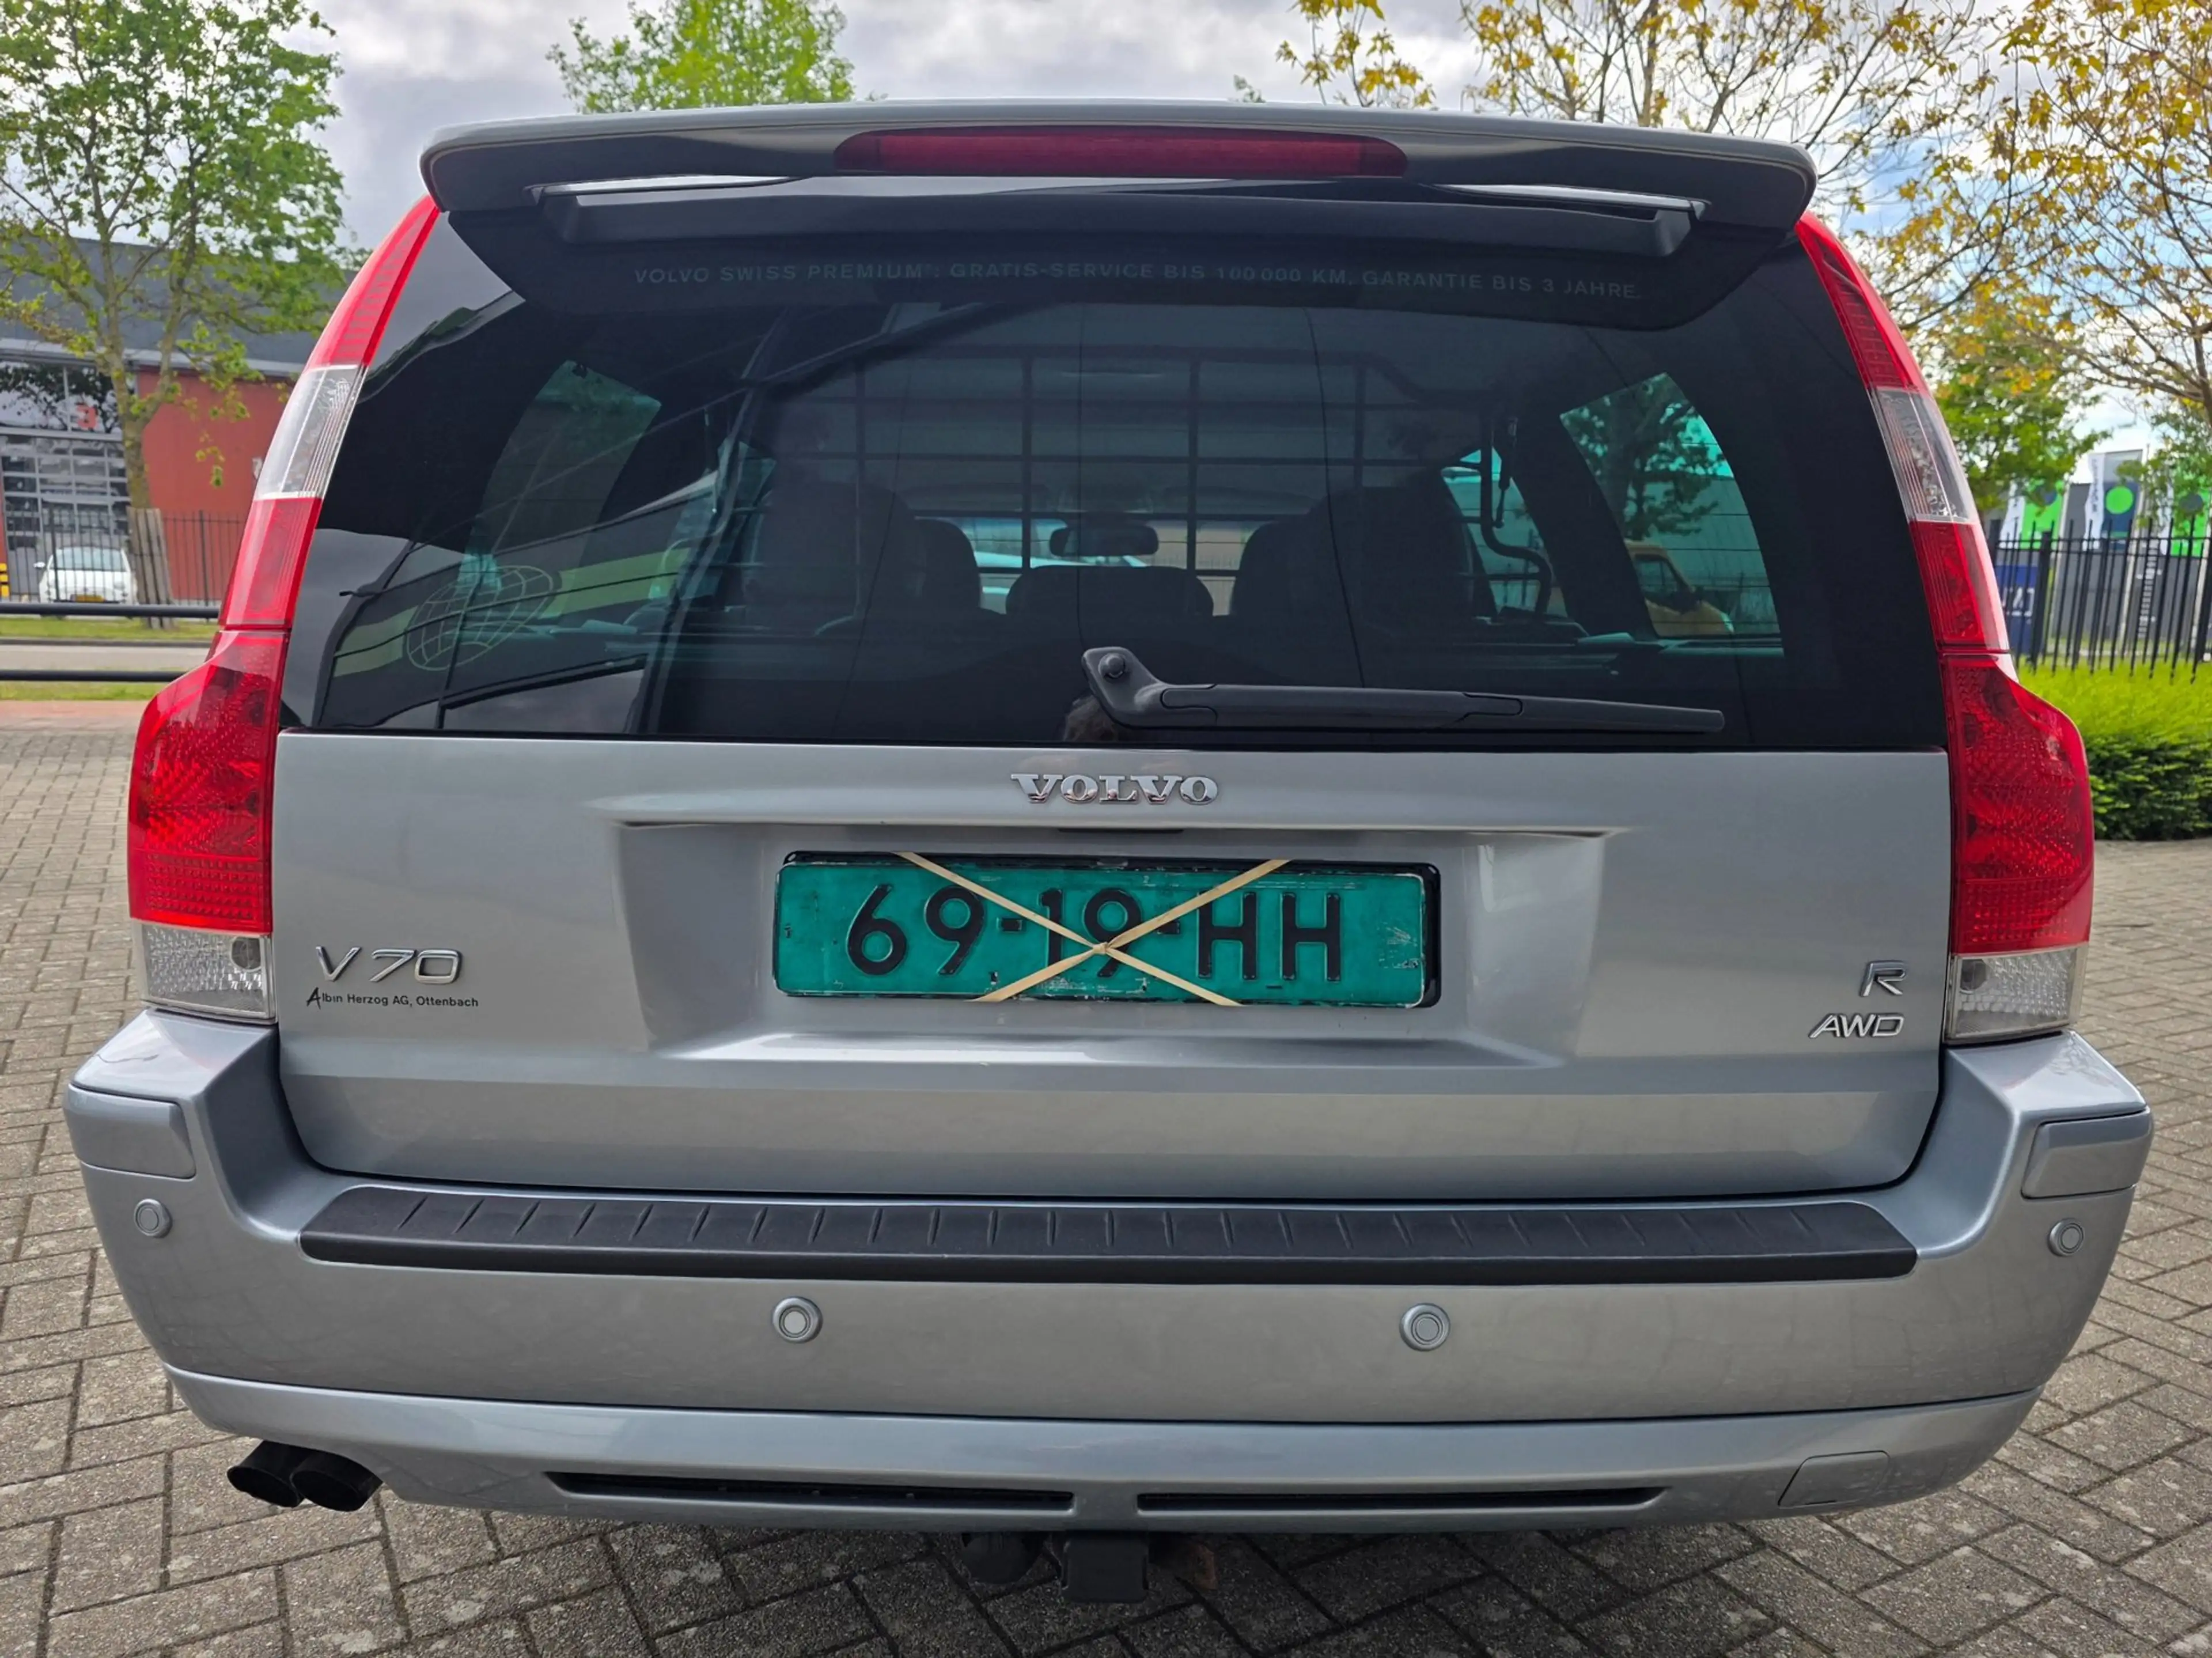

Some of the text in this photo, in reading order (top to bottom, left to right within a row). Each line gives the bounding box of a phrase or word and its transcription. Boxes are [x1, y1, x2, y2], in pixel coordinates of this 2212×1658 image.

[634, 267, 710, 284] VOLVO
[719, 265, 797, 281] SWISS
[949, 262, 1154, 279] GRATIS-SERVICE
[1164, 263, 1206, 279] BIS
[1362, 270, 1484, 290] GARANTIE
[1493, 274, 1532, 292] BIS
[1542, 278, 1554, 293] 3
[1010, 773, 1219, 805] VOLVO
[847, 884, 1342, 982] 69-19-HH
[1858, 959, 1908, 997] R
[306, 986, 479, 1010] Albin Herzog AG, Ottenbach
[1808, 1012, 1905, 1039] AWD
